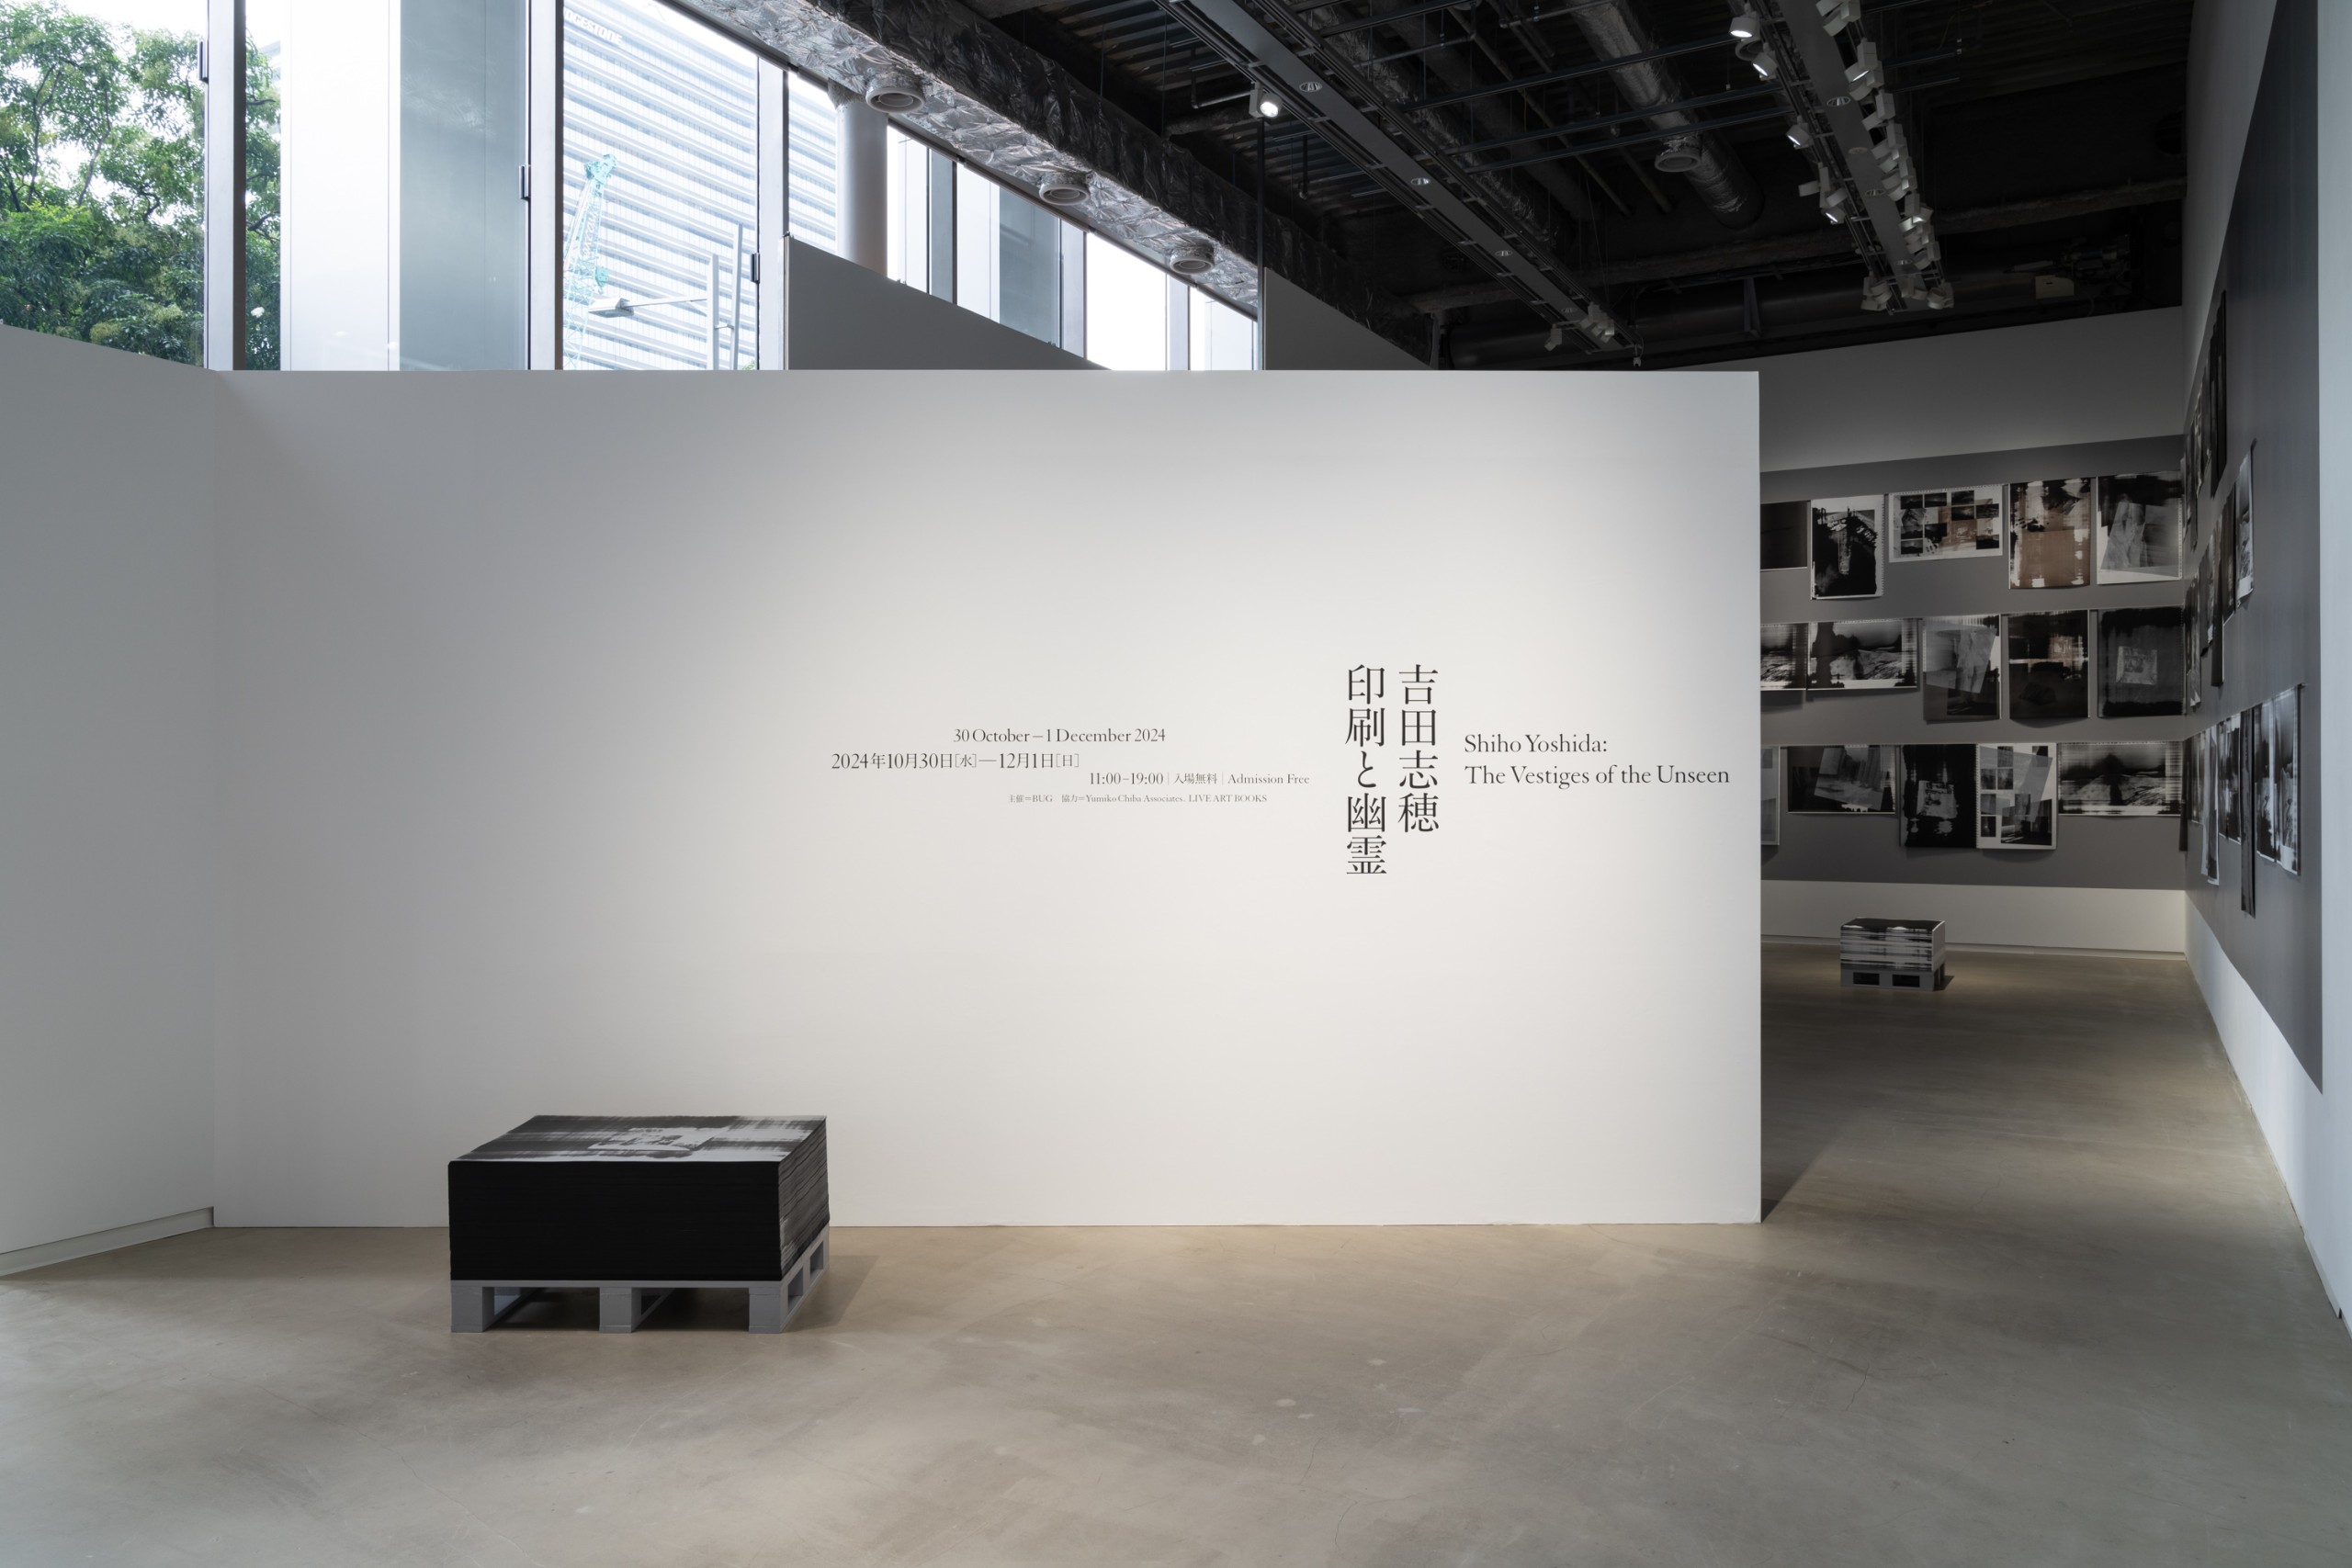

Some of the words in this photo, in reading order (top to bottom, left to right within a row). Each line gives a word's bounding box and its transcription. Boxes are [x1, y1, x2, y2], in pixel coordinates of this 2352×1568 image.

[953, 728, 970, 743] 30
[972, 728, 1031, 743] October
[1056, 728, 1132, 743] December
[1134, 728, 1166, 742] 2024
[1464, 732, 1522, 753] Shiho
[1523, 732, 1608, 753] Yoshida:
[1396, 663, 1440, 834] 吉田志穂
[1172, 772, 1218, 785] 入場無料
[1227, 772, 1284, 784] Admission
[1286, 772, 1310, 784] Free
[1344, 663, 1388, 875] 印刷と幽霊
[1464, 764, 1507, 784] The
[1509, 765, 1590, 791] Vestiges
[1595, 763, 1618, 784] of
[1621, 763, 1652, 784] the
[1656, 764, 1731, 784] Unseen
[1117, 793, 1142, 803] Chiba
[1188, 794, 1212, 803] LIVE
[1212, 794, 1234, 803] ART
[1234, 794, 1268, 803] BOOKS
